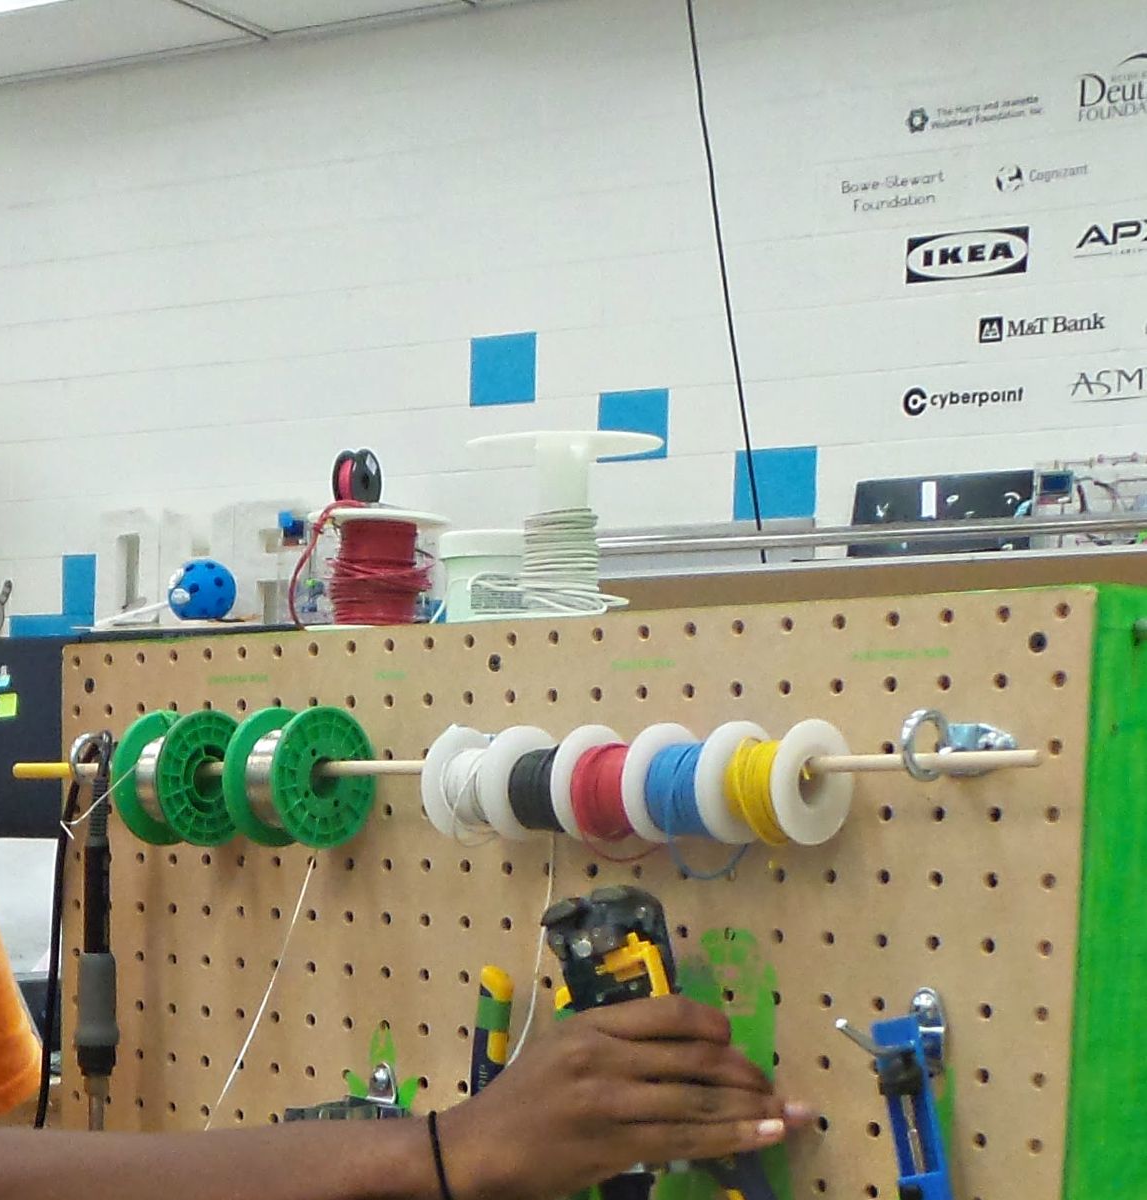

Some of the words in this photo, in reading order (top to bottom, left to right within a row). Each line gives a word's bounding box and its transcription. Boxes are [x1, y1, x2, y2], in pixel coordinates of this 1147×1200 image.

[1028, 164, 1088, 184] Cognizant
[853, 193, 936, 213] Foundation
[1075, 220, 1147, 249] AP
[922, 241, 1015, 268] IKEA
[1006, 316, 1049, 338] M&T
[1052, 313, 1106, 334] Bank
[930, 386, 1025, 408] cyberpoint
